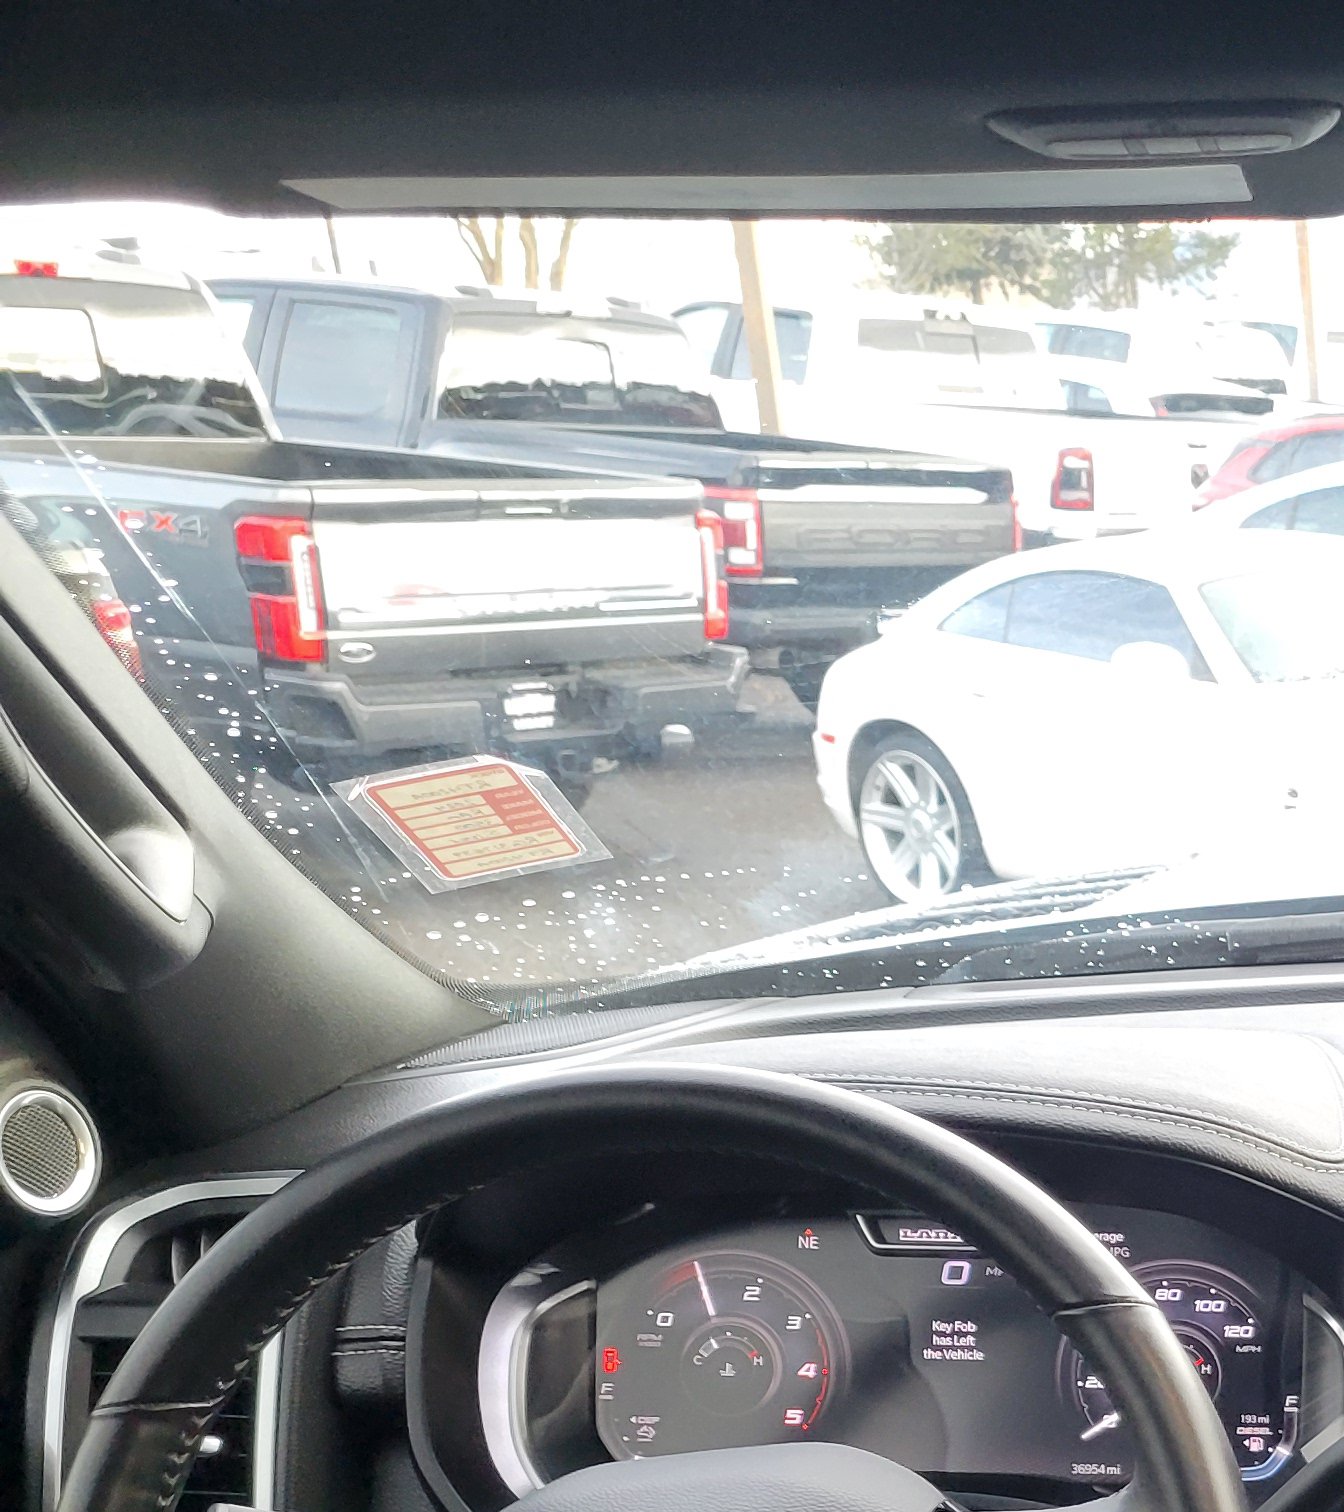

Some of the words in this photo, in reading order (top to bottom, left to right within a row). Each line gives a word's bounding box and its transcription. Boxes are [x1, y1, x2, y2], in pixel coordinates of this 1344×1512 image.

[798, 1236, 820, 1250] NE
[940, 1260, 972, 1286] 0
[742, 1284, 762, 1301] 2
[1155, 1288, 1182, 1301] 80
[1194, 1300, 1226, 1313] 100
[656, 1311, 675, 1328] 0
[785, 1315, 803, 1330] 3
[932, 1320, 953, 1334] Key
[954, 1319, 978, 1332] Fob
[1223, 1325, 1254, 1338] 120
[932, 1334, 952, 1346] has
[953, 1334, 975, 1346] Left
[923, 1348, 942, 1360] the
[942, 1348, 985, 1361] Vehicle
[797, 1362, 818, 1379] 4
[784, 1408, 806, 1426] 5
[1240, 1414, 1257, 1424] 193
[1258, 1413, 1270, 1424] mi
[1071, 1463, 1106, 1475] 36954
[1106, 1462, 1121, 1475] mi
